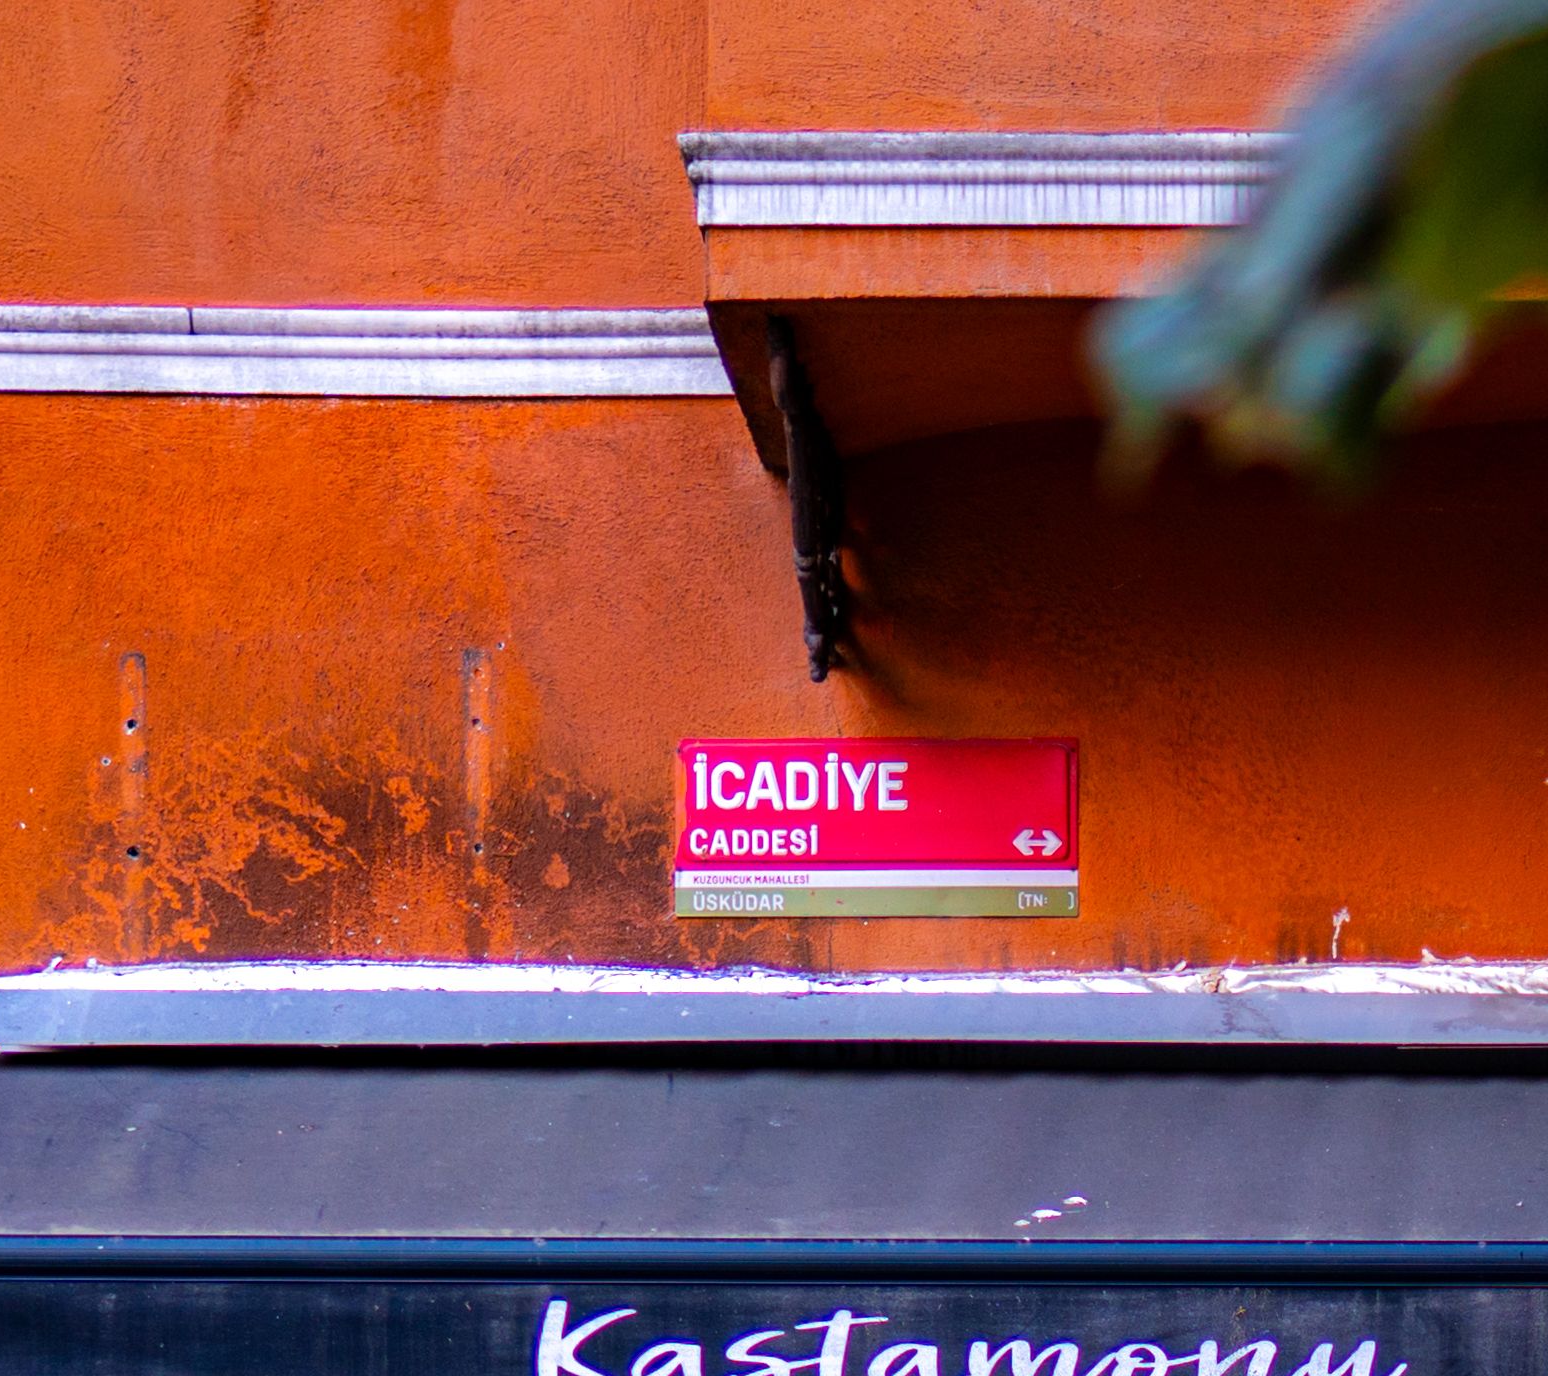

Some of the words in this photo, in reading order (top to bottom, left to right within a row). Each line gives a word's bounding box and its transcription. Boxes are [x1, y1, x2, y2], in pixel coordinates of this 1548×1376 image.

[693, 752, 908, 812] İCADİYE
[689, 824, 819, 856] CADDESİ
[693, 876, 752, 885] KUZGUNCUK
[754, 875, 810, 885] MAHALLESİ
[693, 891, 785, 912] ÜSKÜDAR
